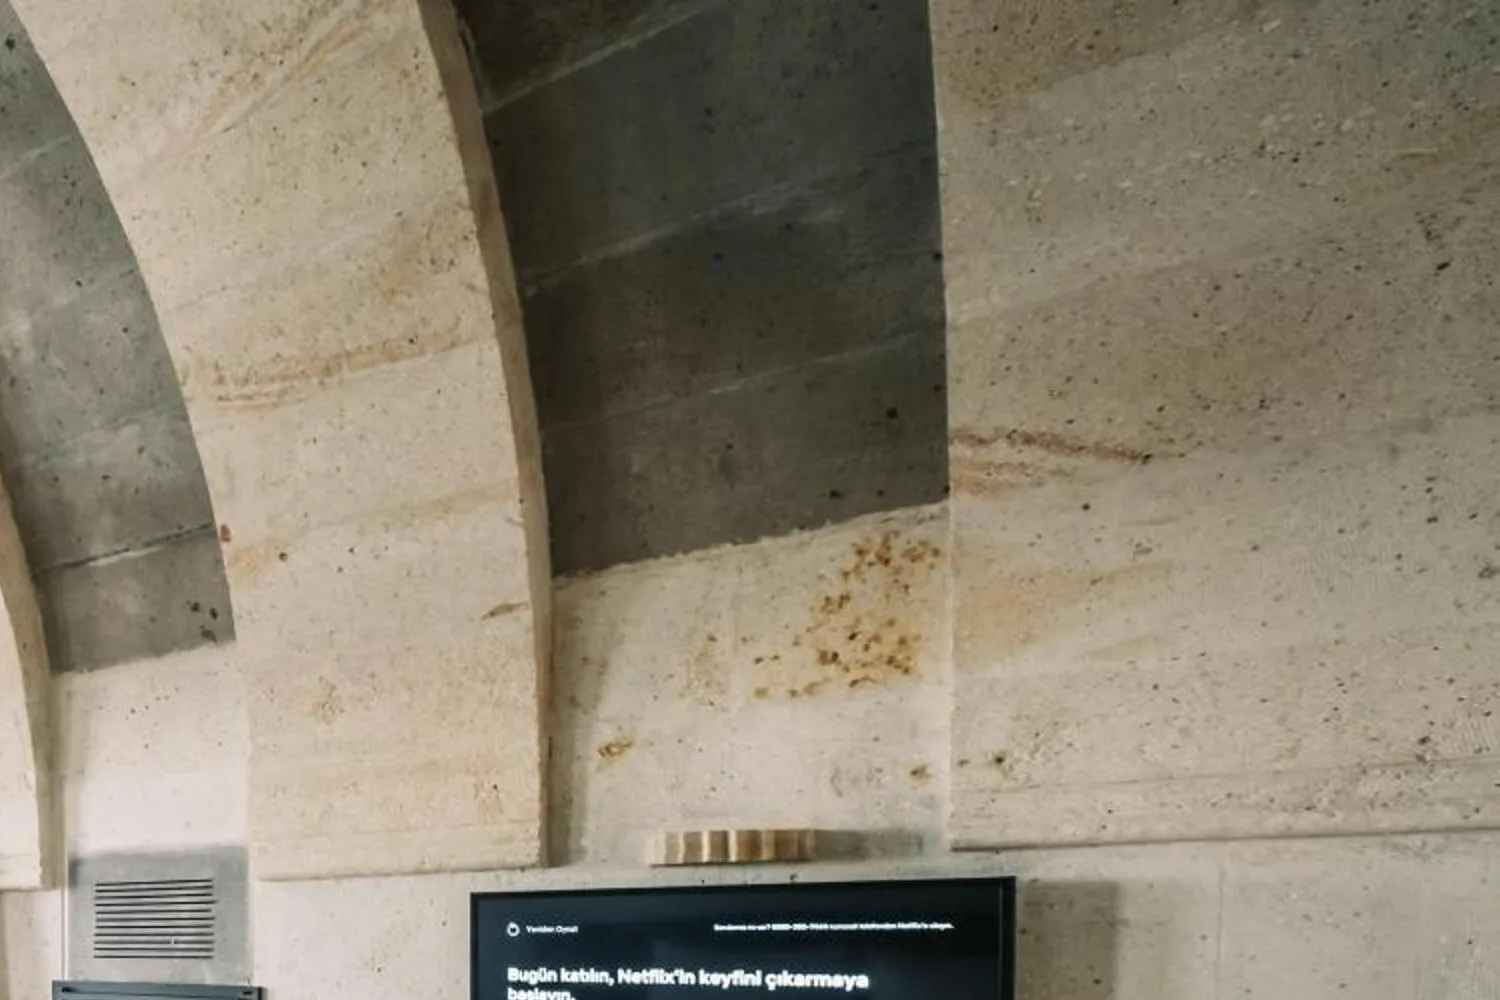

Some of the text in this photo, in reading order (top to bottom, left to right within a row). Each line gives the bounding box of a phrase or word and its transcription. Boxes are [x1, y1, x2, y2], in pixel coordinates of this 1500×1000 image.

[507, 967, 558, 985] Bugün
[617, 968, 696, 985] Netflix'in
[698, 969, 762, 989] keyfini
[765, 969, 869, 992] çıkarmaya
